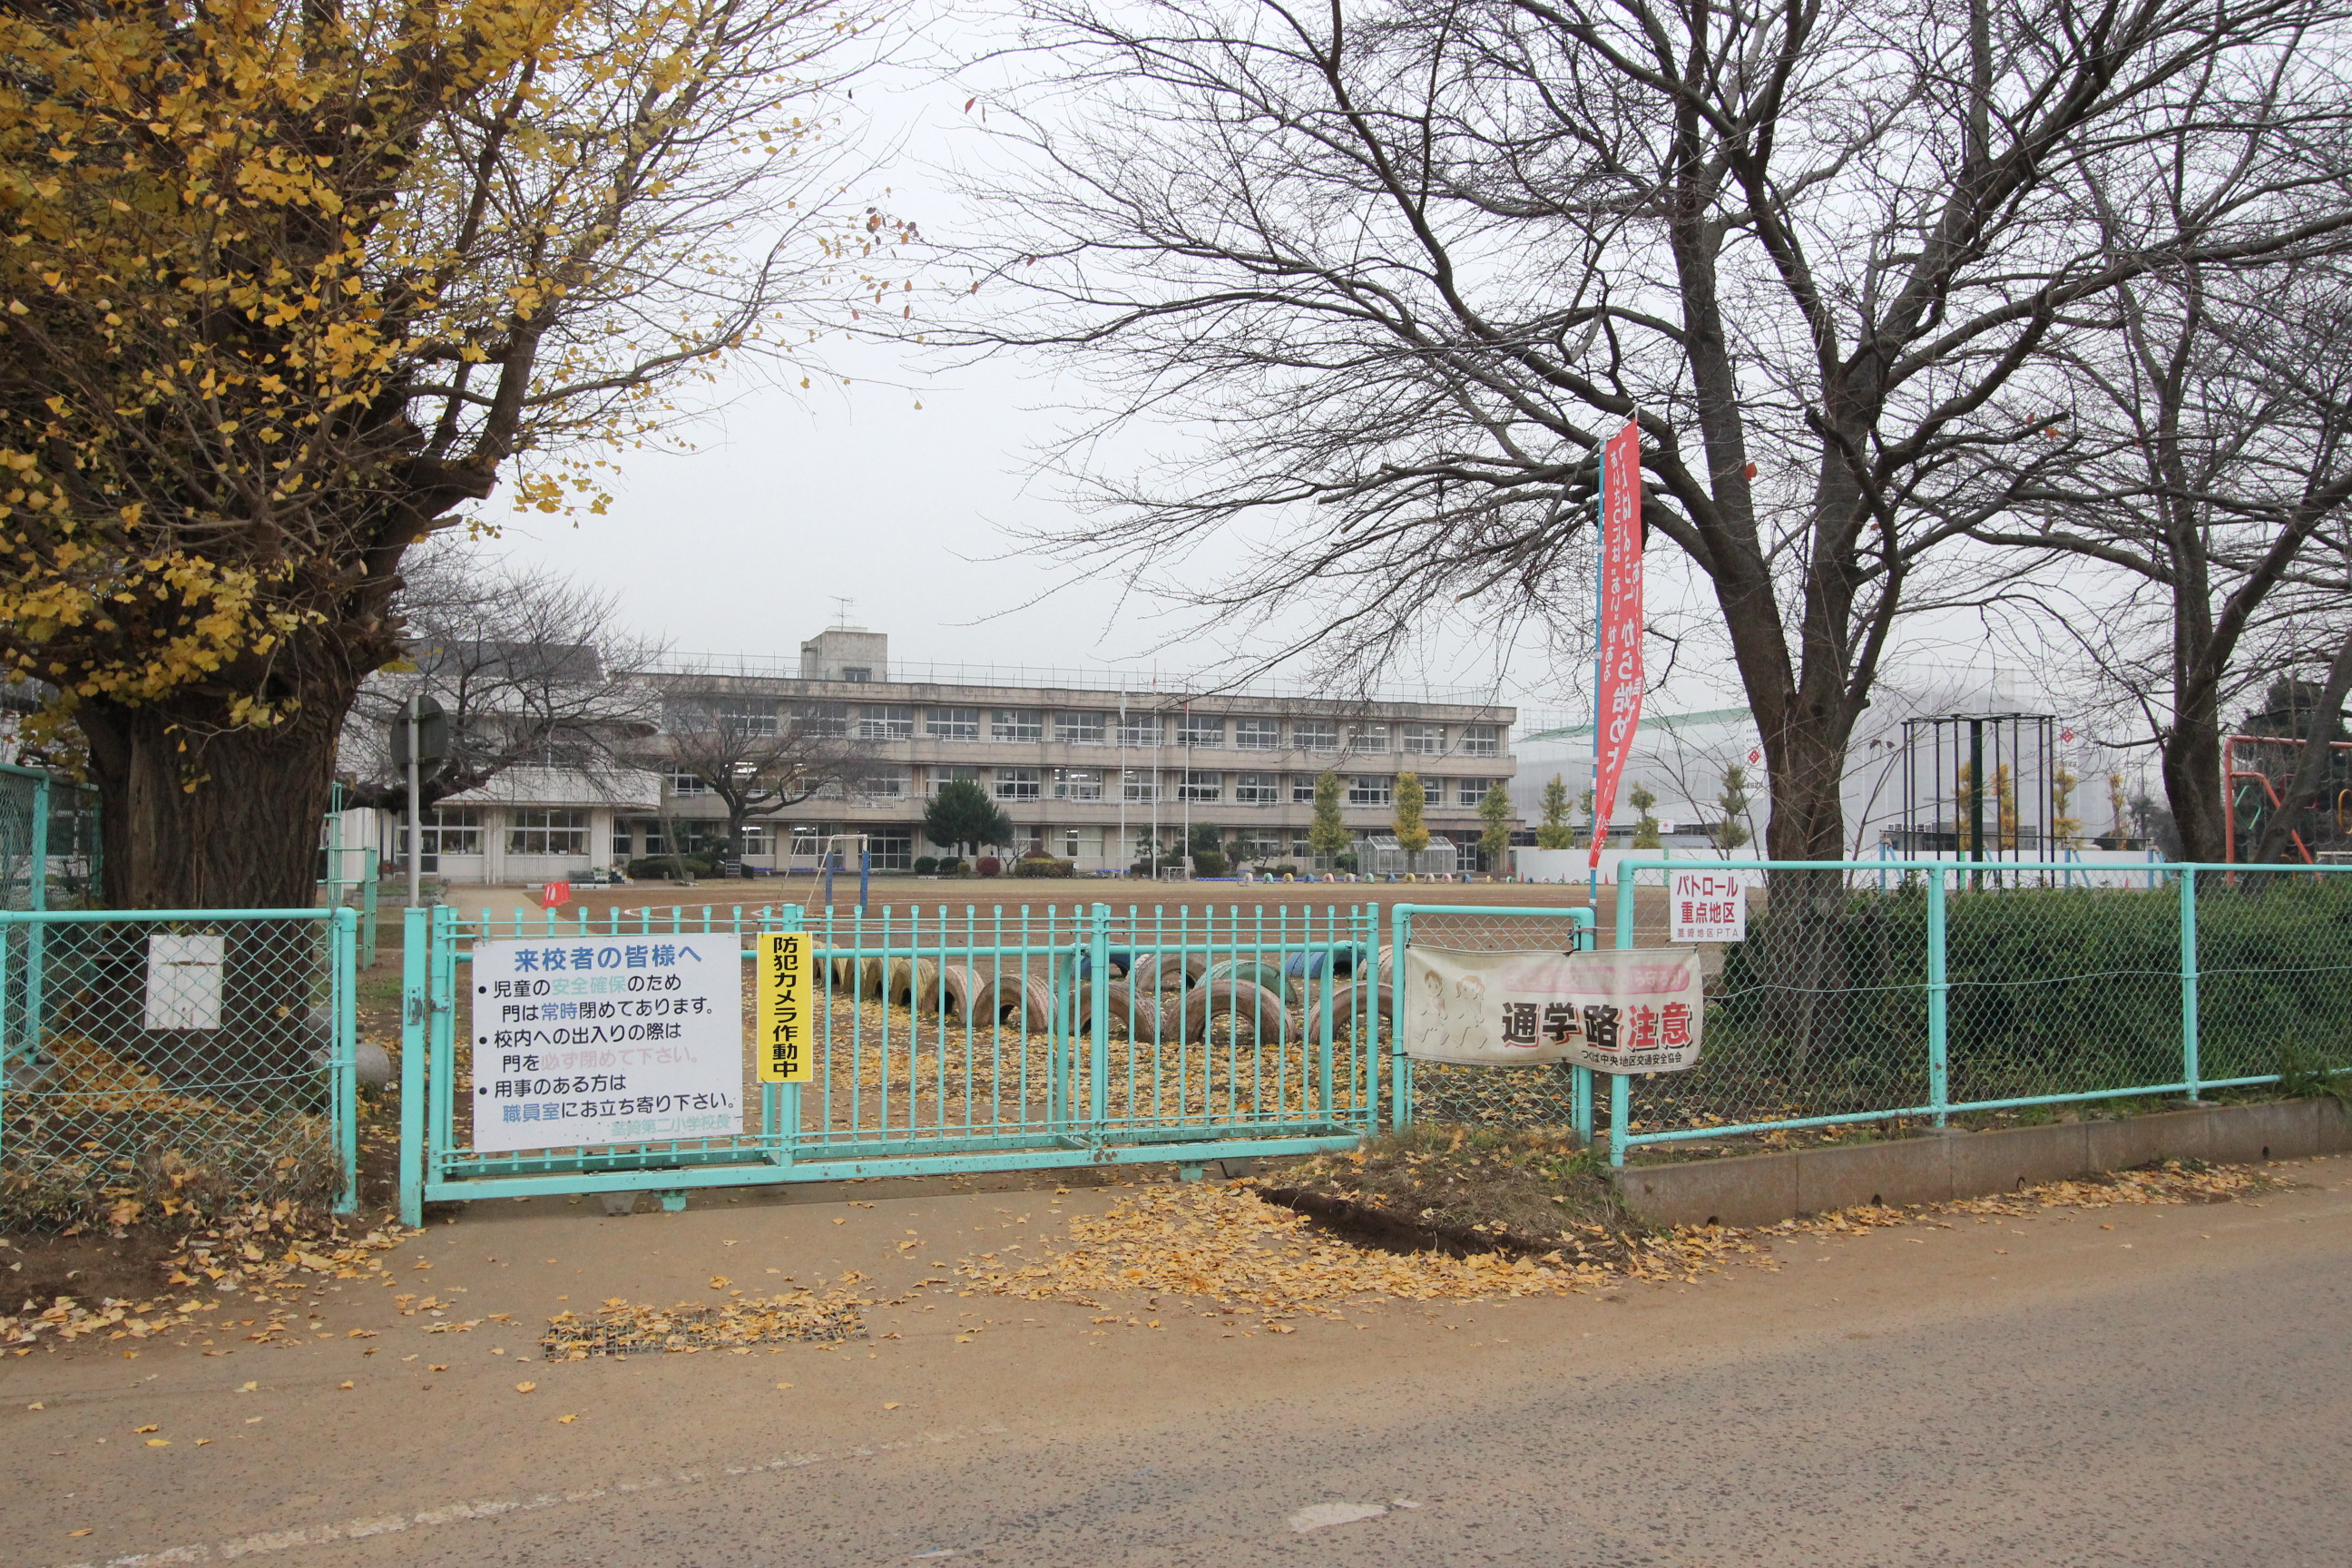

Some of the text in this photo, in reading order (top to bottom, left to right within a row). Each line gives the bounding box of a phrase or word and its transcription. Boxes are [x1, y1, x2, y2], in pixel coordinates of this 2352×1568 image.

[1677, 875, 1739, 897] パトロール
[1681, 901, 1735, 924] 重点地区
[514, 944, 701, 973] 来校者の皆様へ
[494, 974, 681, 998] 児童の安全確保のため
[503, 996, 712, 1023] 門は常時閉めてあります。
[772, 936, 799, 1078] 防犯カメラ作動中
[494, 1022, 681, 1048] 校内への出入りの際は
[1502, 1001, 1692, 1051] 通学路注意
[1582, 1051, 1682, 1066] つくば中央地区交通安全協会
[495, 1074, 626, 1098] 用事のある方は
[503, 1093, 733, 1123] 職員室にお立ち寄り下さい。
